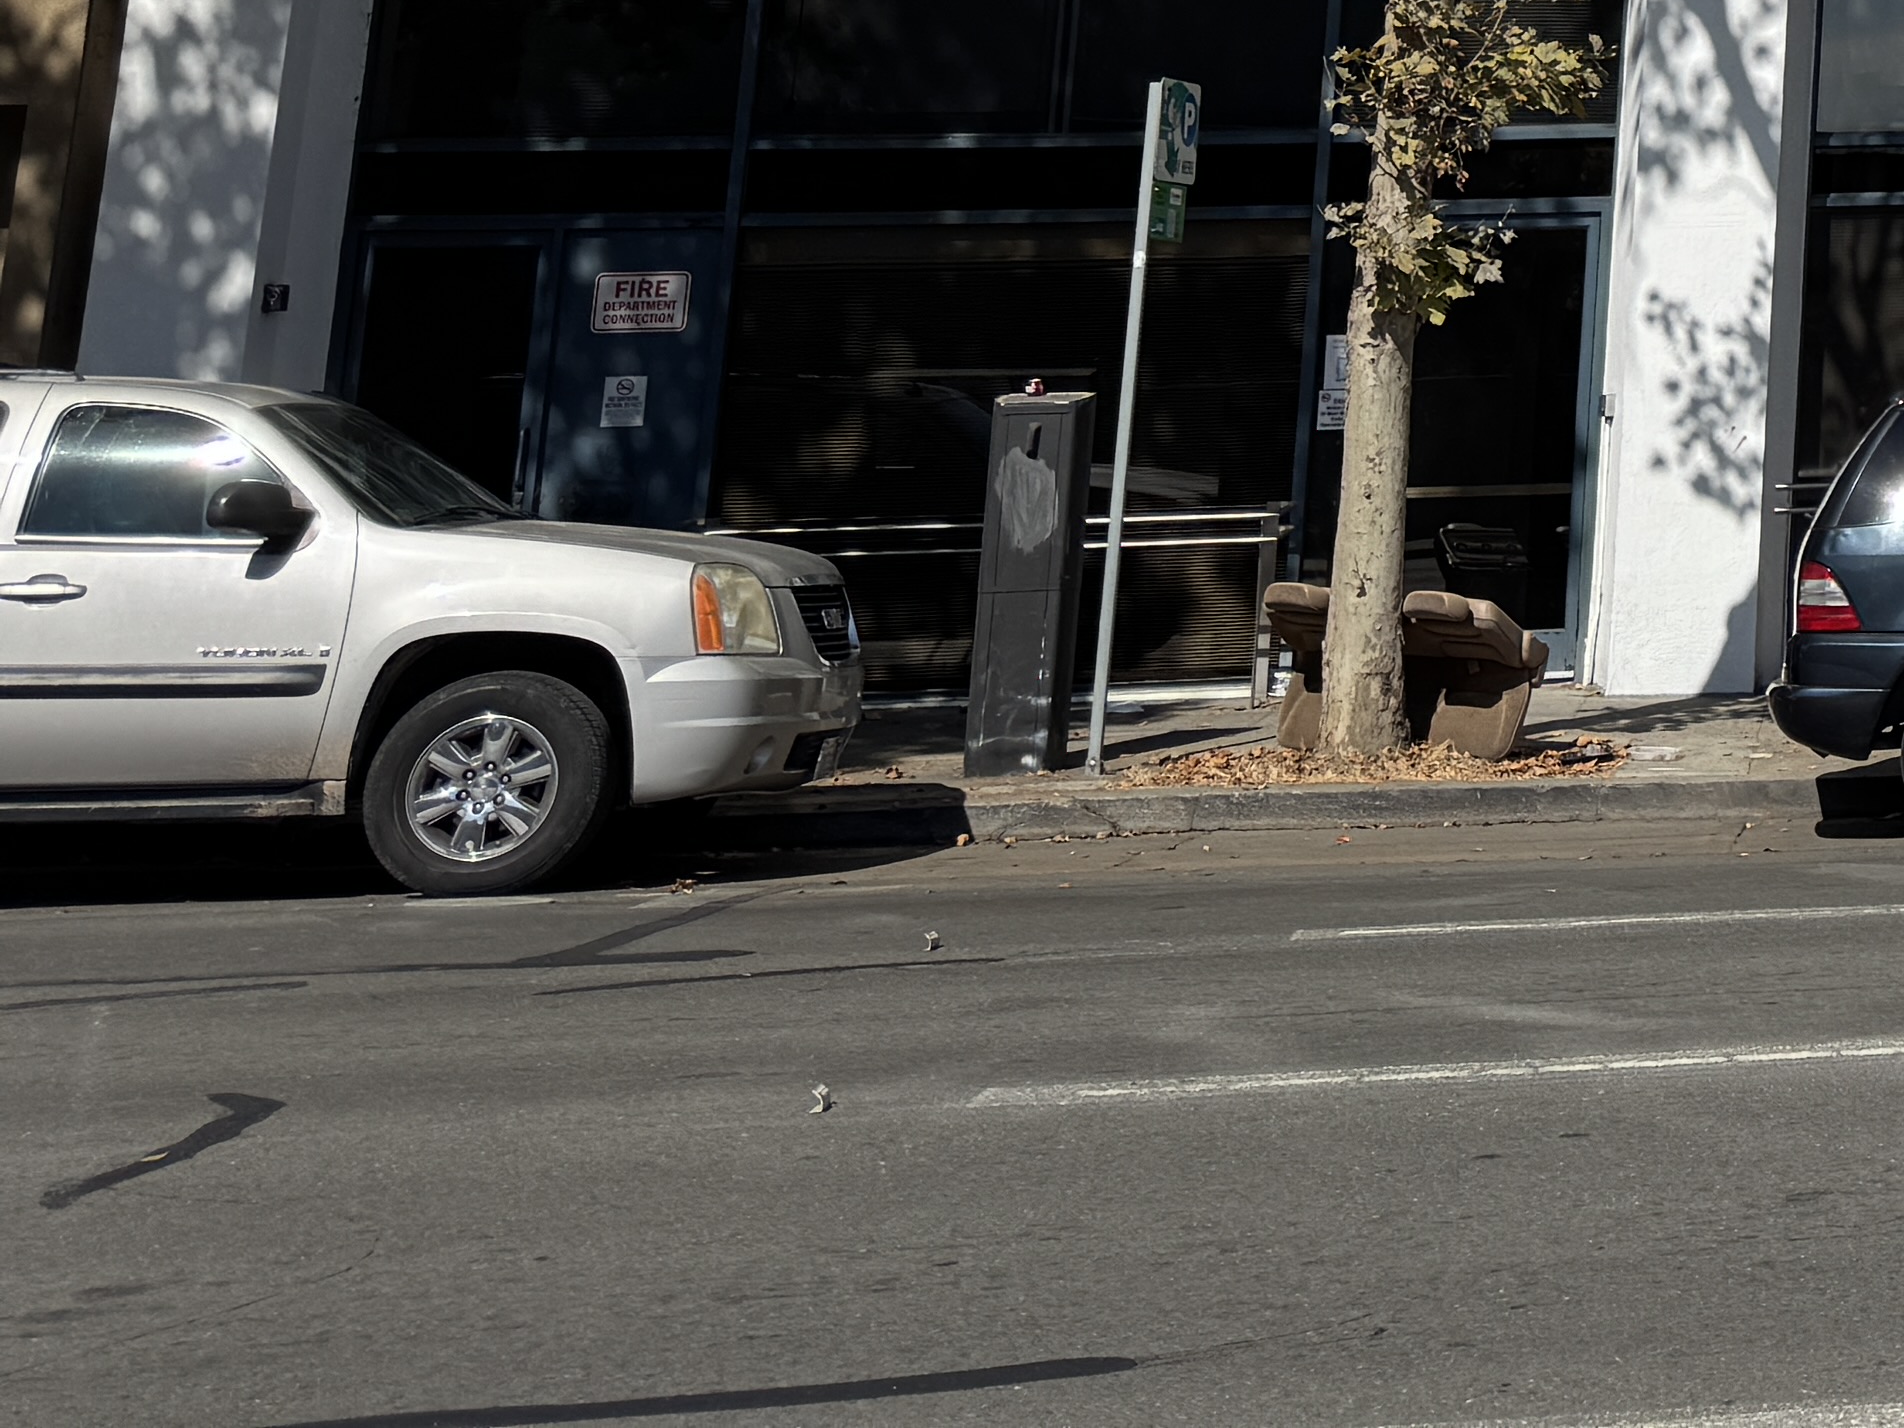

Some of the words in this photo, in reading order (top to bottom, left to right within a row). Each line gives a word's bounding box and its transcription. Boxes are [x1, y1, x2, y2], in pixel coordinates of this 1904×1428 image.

[1183, 102, 1196, 139] P
[615, 279, 669, 298] FIRE
[603, 300, 677, 311] DEPARTMENT
[603, 313, 674, 325] CONNECTION
